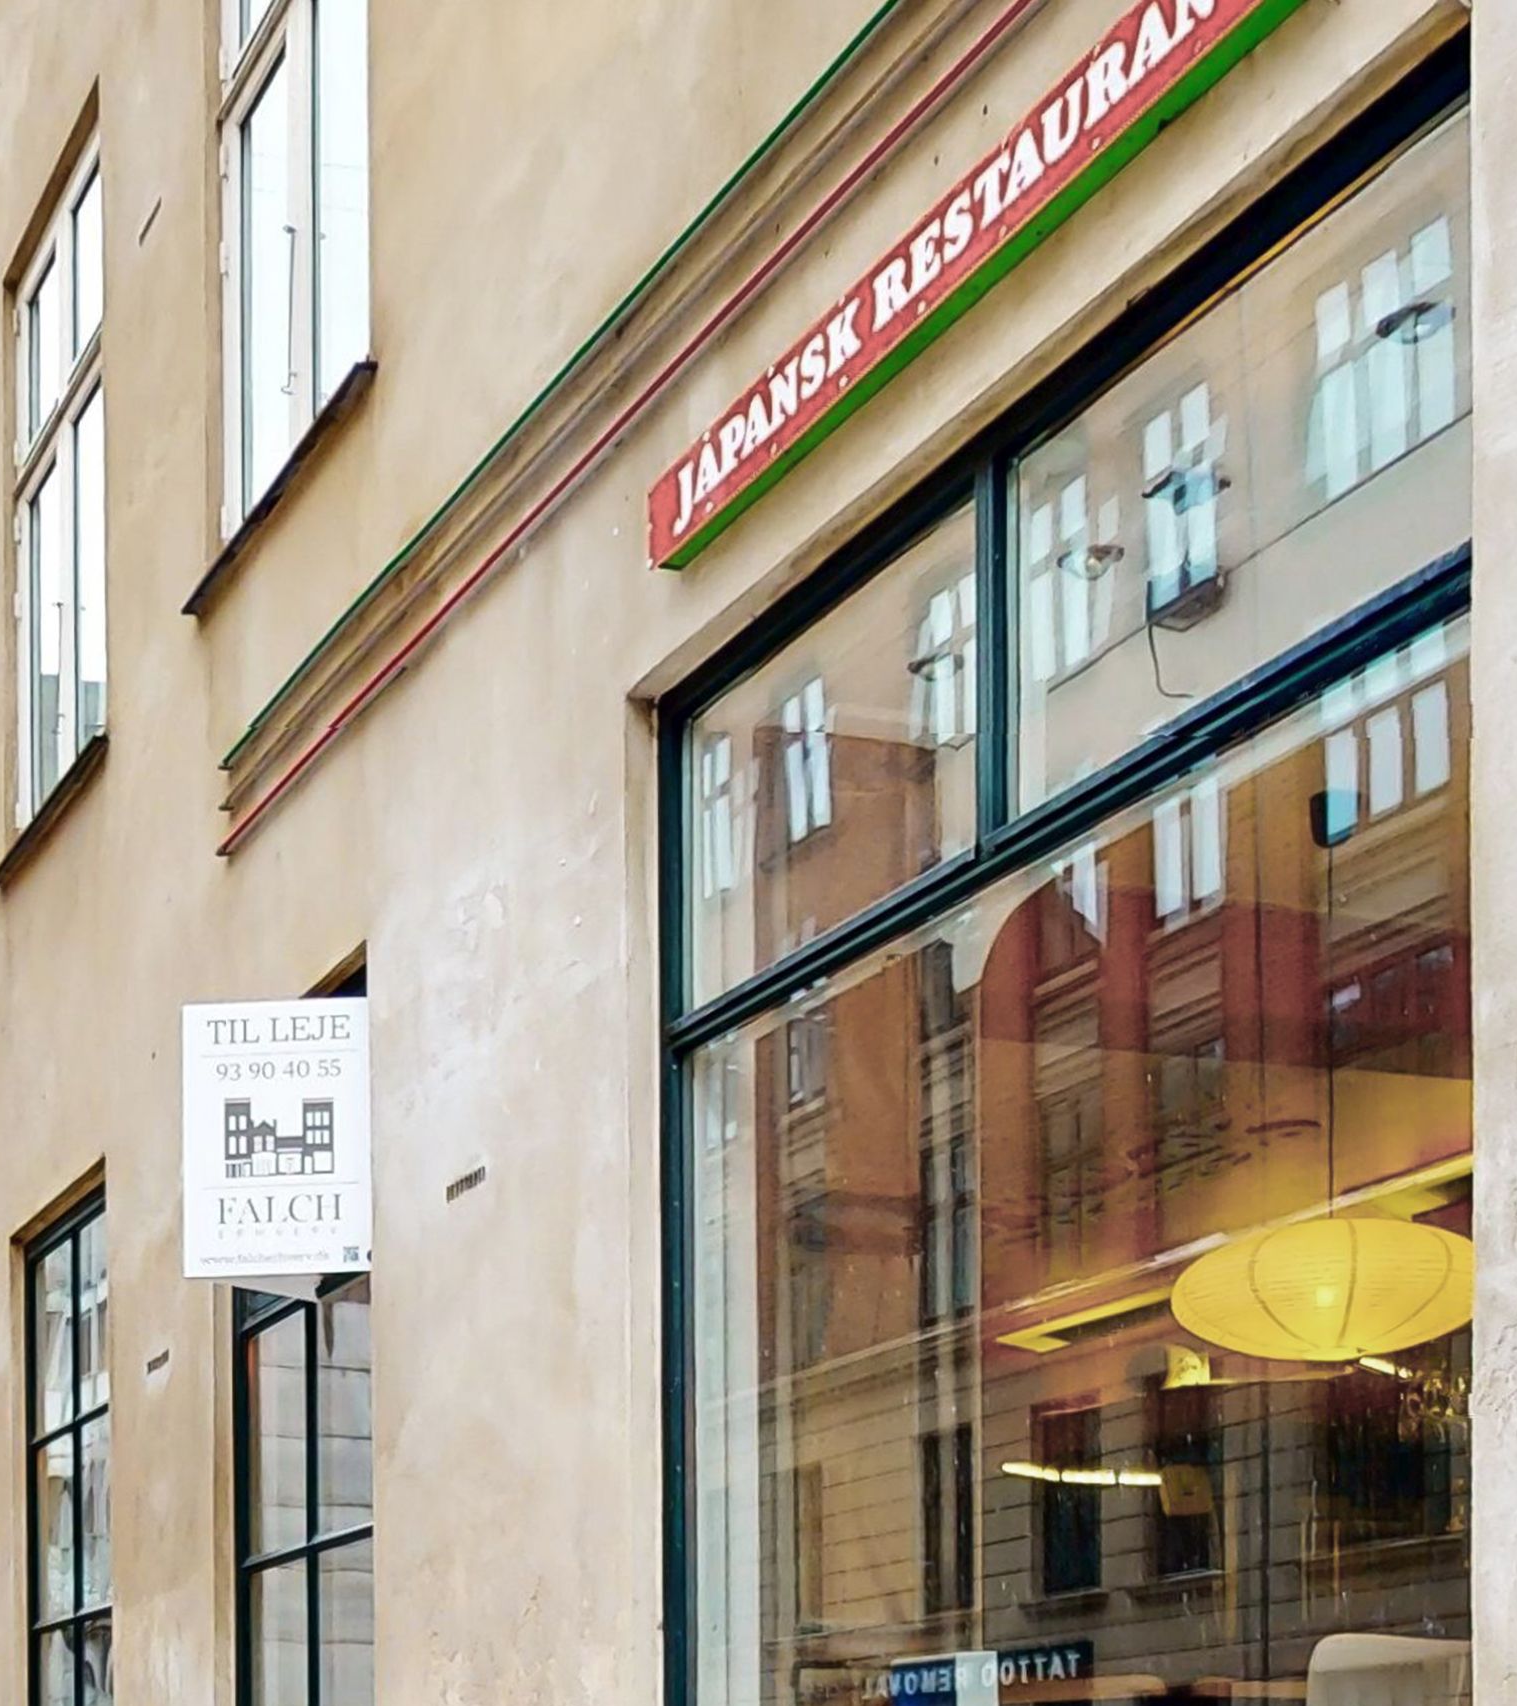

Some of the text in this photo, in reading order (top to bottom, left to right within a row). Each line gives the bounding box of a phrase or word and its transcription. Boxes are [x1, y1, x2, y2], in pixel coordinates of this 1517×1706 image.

[672, 297, 861, 536] JAPANSK
[207, 1014, 351, 1045] TIL LEJE
[216, 1058, 342, 1081] 93 90 40 55
[218, 1193, 342, 1225] FALCH
